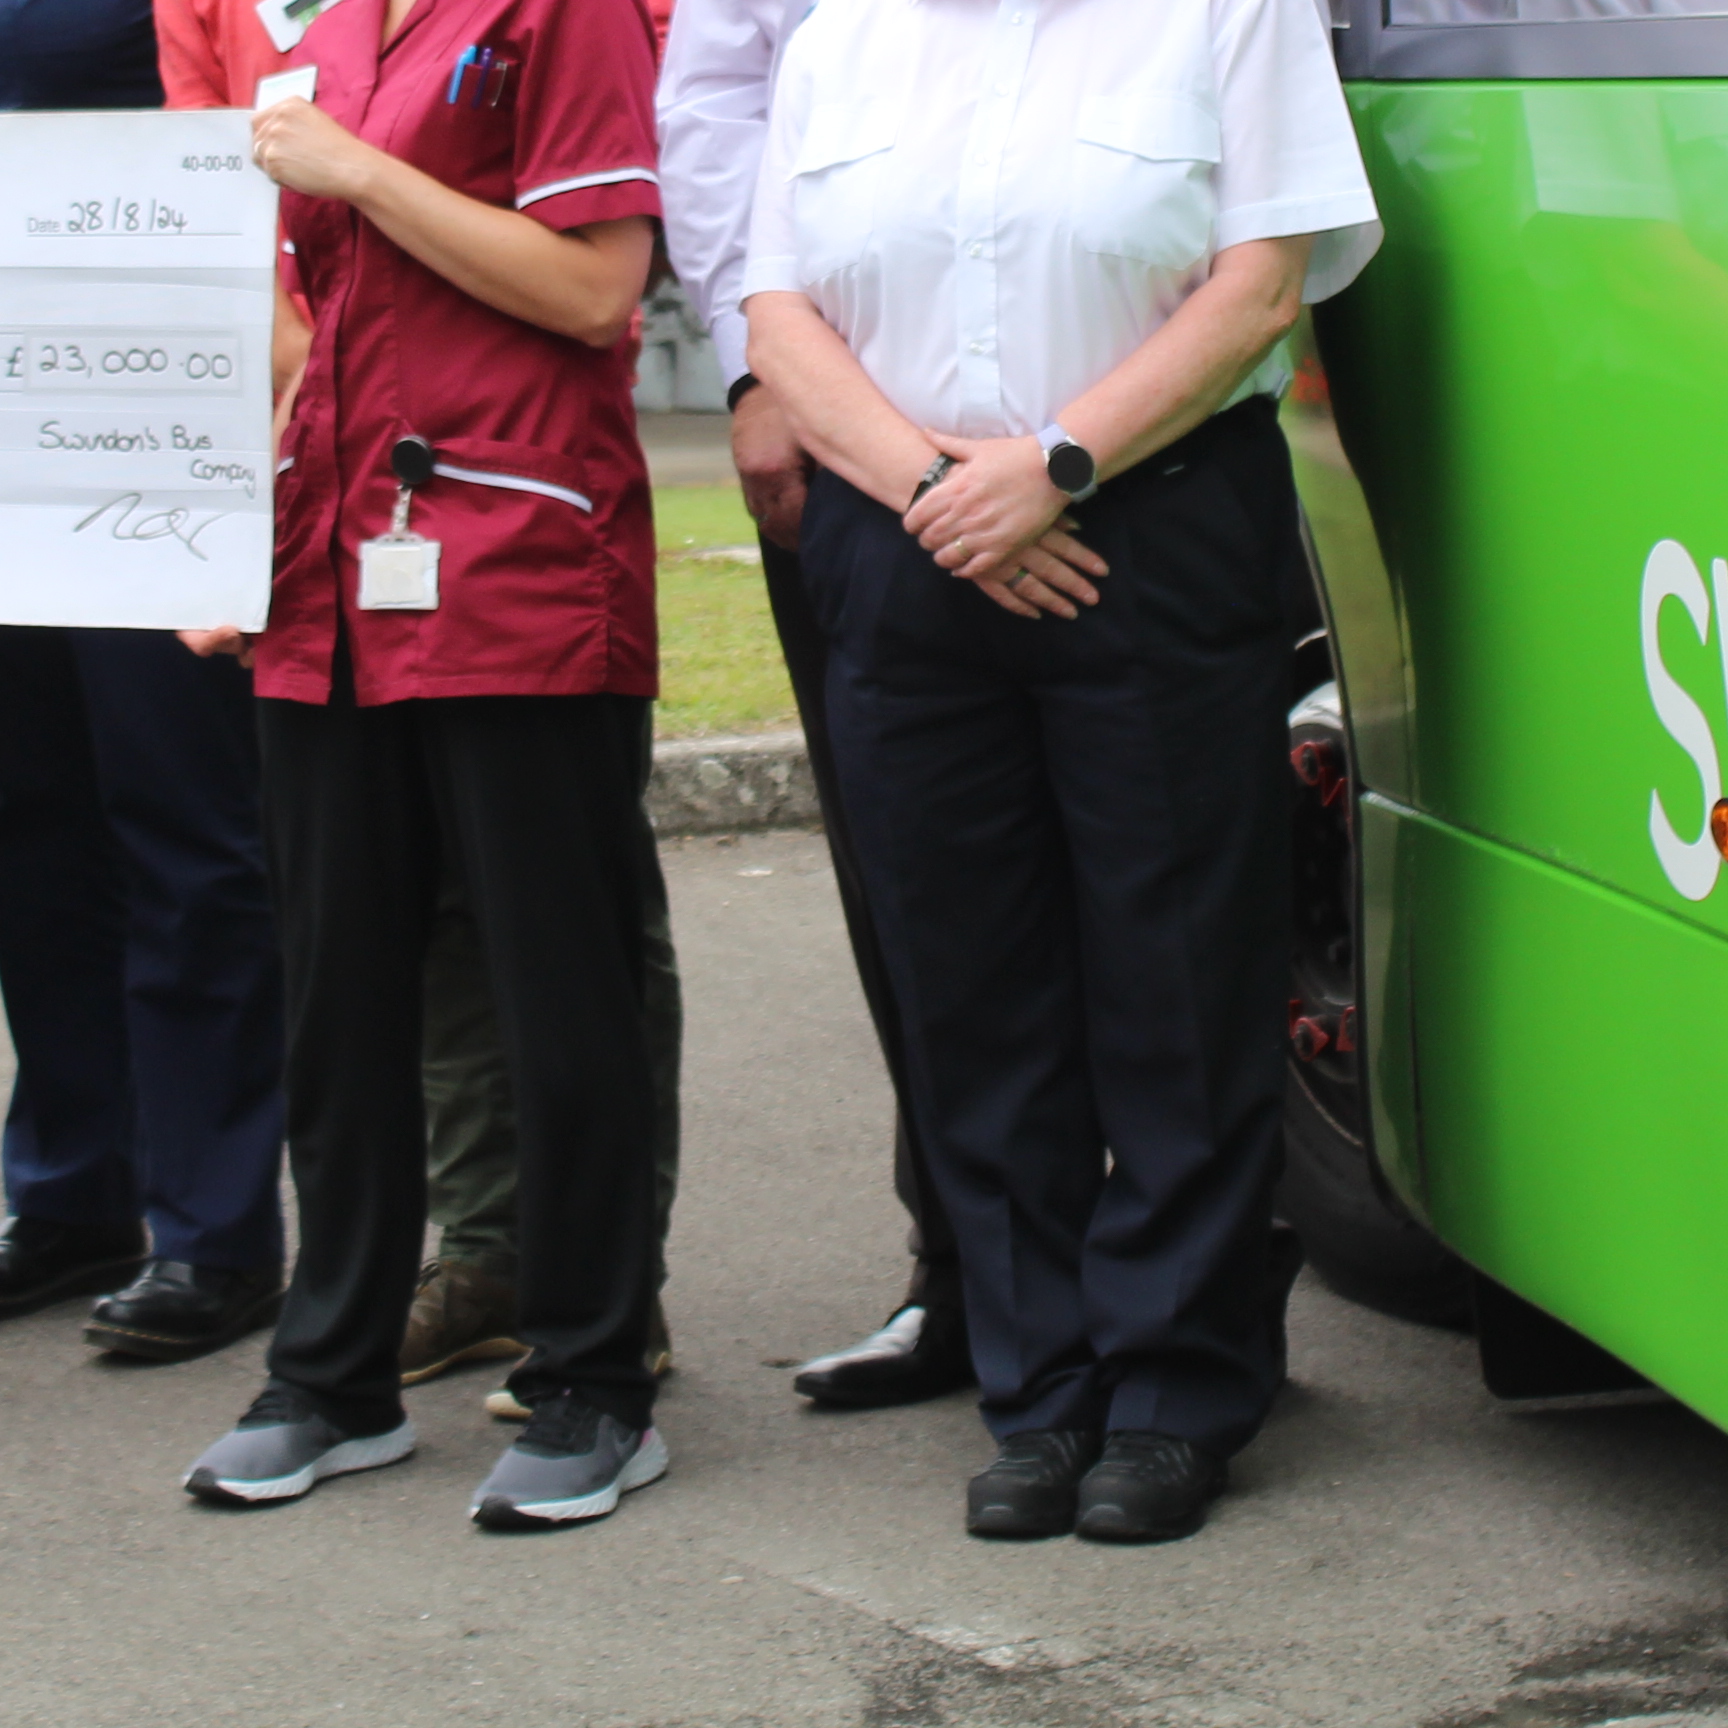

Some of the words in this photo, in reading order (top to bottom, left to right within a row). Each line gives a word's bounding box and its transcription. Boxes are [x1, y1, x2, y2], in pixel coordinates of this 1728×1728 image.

[181, 156, 243, 172] 40-00-00
[27, 217, 61, 234] Date
[38, 420, 161, 453] Swindon's
[171, 424, 214, 451] Bus
